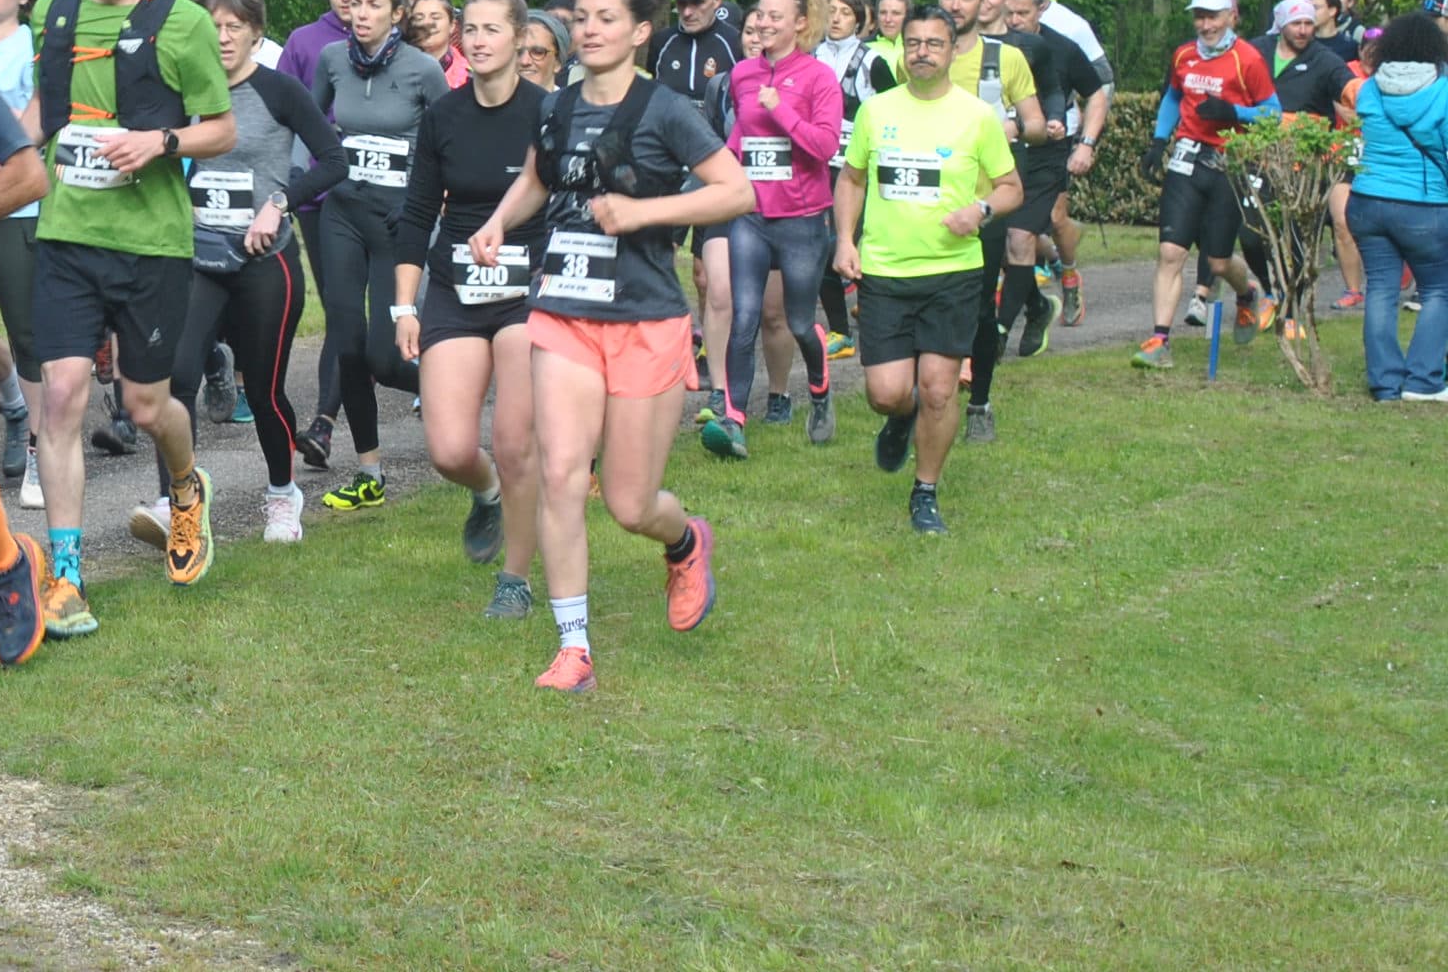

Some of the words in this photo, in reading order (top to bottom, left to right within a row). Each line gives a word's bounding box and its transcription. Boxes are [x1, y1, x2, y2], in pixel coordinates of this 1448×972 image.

[356, 150, 391, 170] 125
[750, 151, 777, 166] 162
[894, 168, 920, 186] 36
[206, 189, 230, 209] 39
[466, 264, 508, 285] 200
[562, 253, 589, 278] 38
